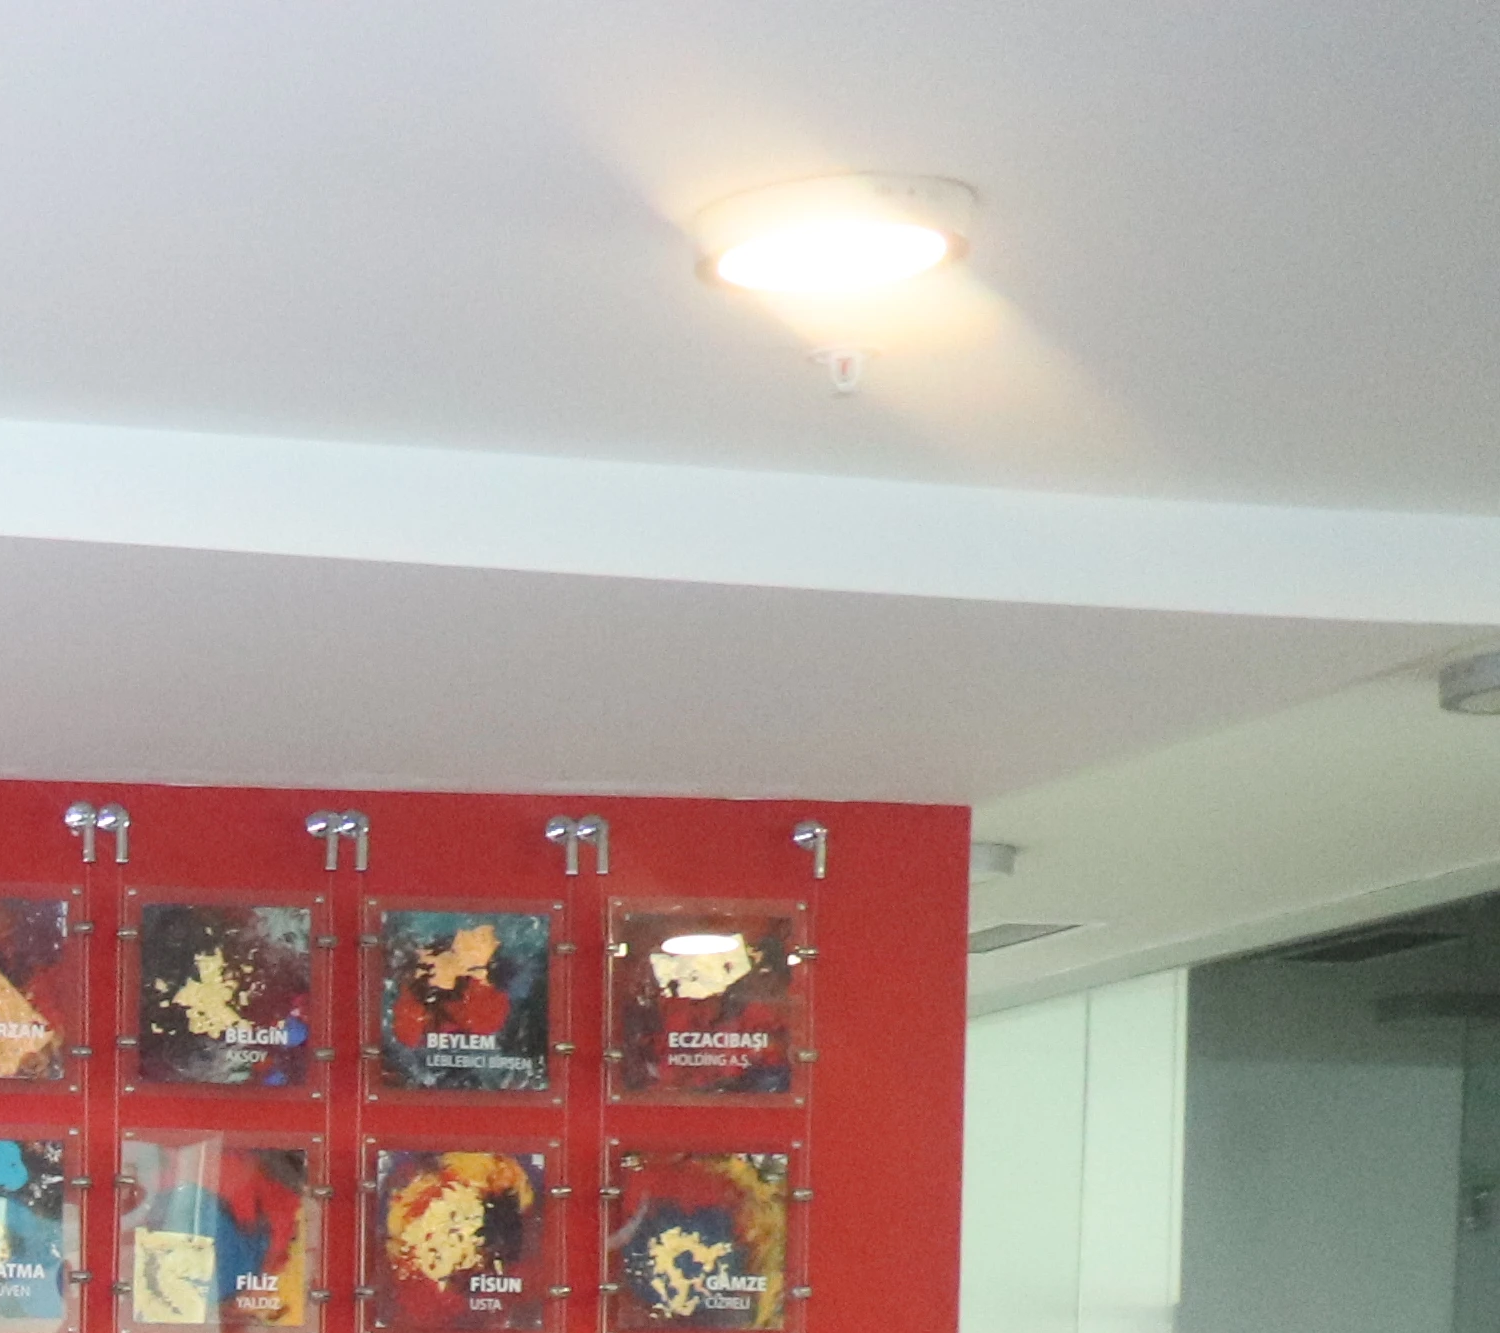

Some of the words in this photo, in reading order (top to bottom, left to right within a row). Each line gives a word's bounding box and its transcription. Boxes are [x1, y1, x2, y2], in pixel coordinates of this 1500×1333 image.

[426, 1032, 496, 1050] BEYLEM
[668, 1032, 768, 1052] ECZACIBAŞI
[235, 1272, 279, 1291] FİLİZ
[470, 1274, 522, 1293] FİSUN
[706, 1275, 768, 1292] GAMZE
[470, 1298, 502, 1311] USTA
